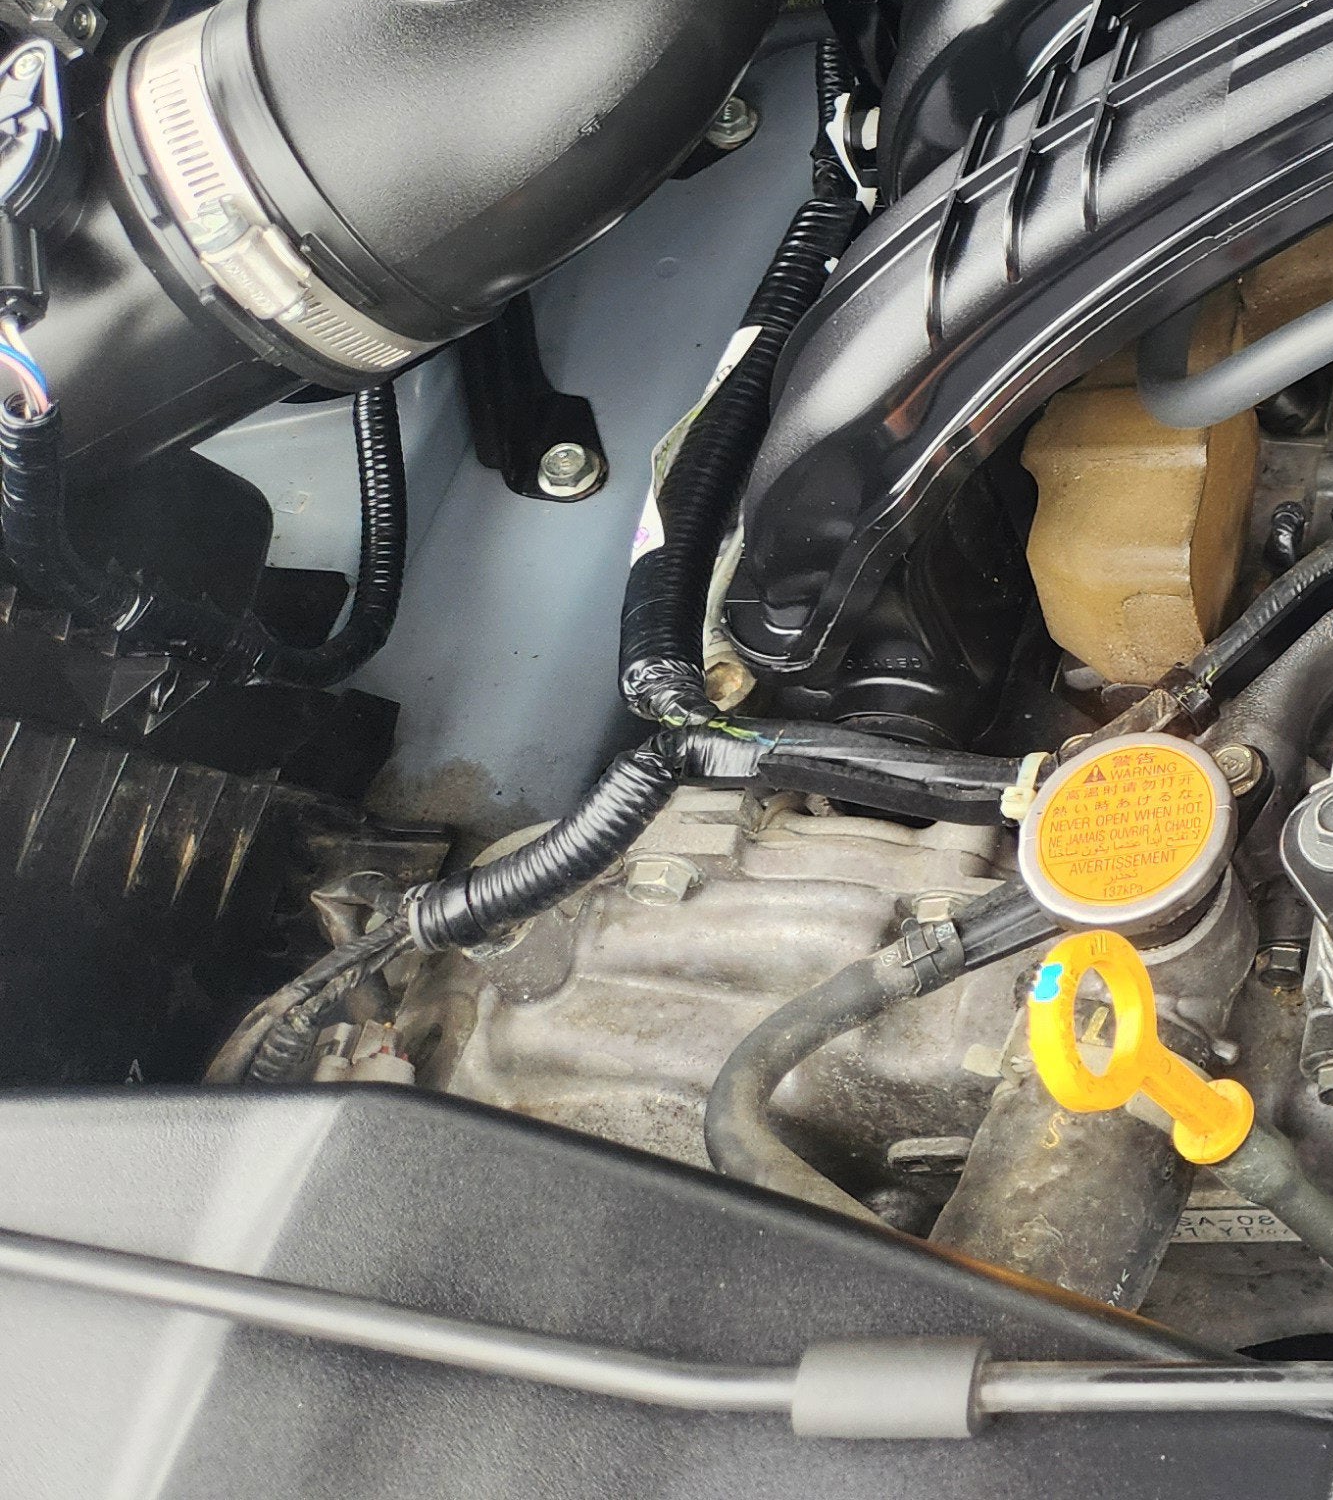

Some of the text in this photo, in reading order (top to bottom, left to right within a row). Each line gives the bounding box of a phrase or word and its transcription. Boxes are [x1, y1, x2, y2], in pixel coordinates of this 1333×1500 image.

[1110, 762, 1178, 781] WARNING
[1050, 802, 1204, 834] NEVER OPEN WHEN HOT.
[1049, 836, 1062, 848] NE
[1066, 830, 1105, 846] JAMAIS
[1109, 824, 1150, 840] OUVRIR
[1069, 848, 1177, 876] AVERTISSEMENT
[1103, 884, 1144, 898] 137kPa
